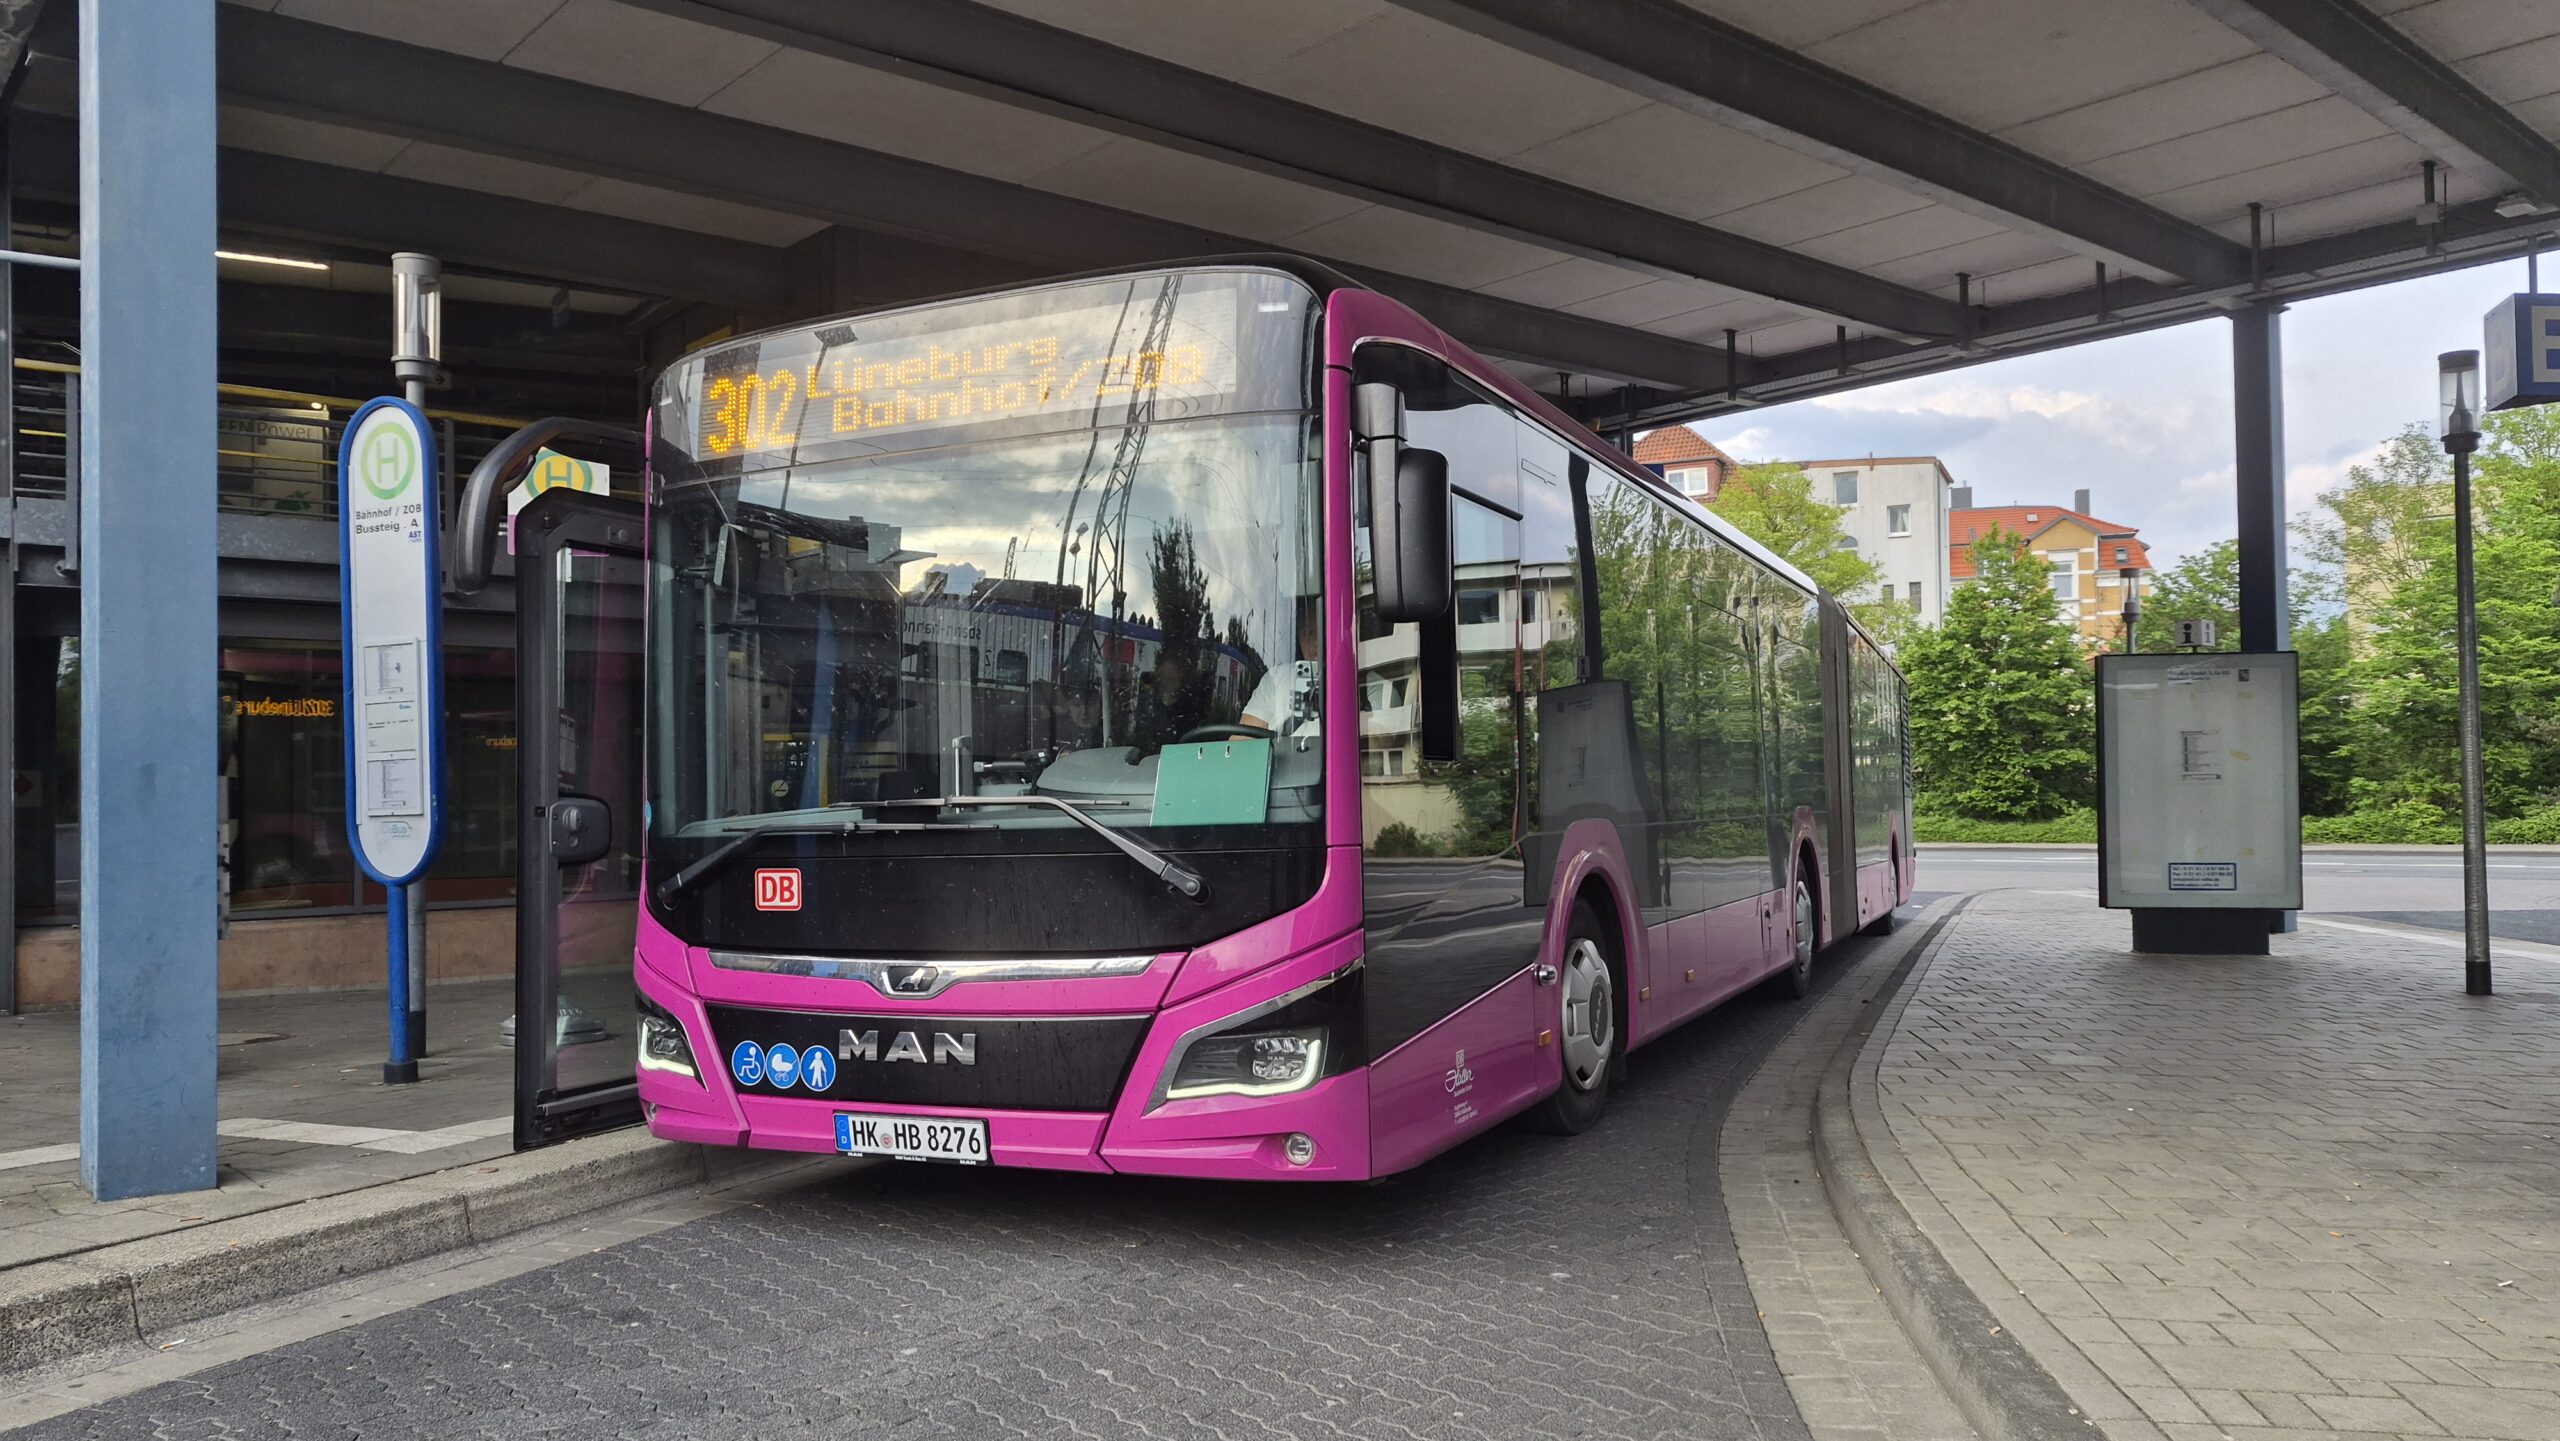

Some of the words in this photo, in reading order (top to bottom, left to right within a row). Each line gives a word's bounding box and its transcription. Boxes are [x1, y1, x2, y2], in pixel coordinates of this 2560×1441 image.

[707, 368, 797, 454] 302
[807, 336, 1058, 400] Lüneburg
[256, 421, 313, 438] Power
[376, 438, 399, 483] H
[355, 521, 400, 534] Bussteig
[410, 518, 419, 528] A
[356, 506, 392, 520] Bahnhof
[403, 503, 422, 514] ZOB
[760, 874, 796, 904] DB
[838, 1029, 977, 1066] MAN
[841, 1136, 848, 1144] D
[852, 1120, 880, 1147] HK
[893, 1122, 922, 1150] HB
[927, 1125, 981, 1155] 8276
